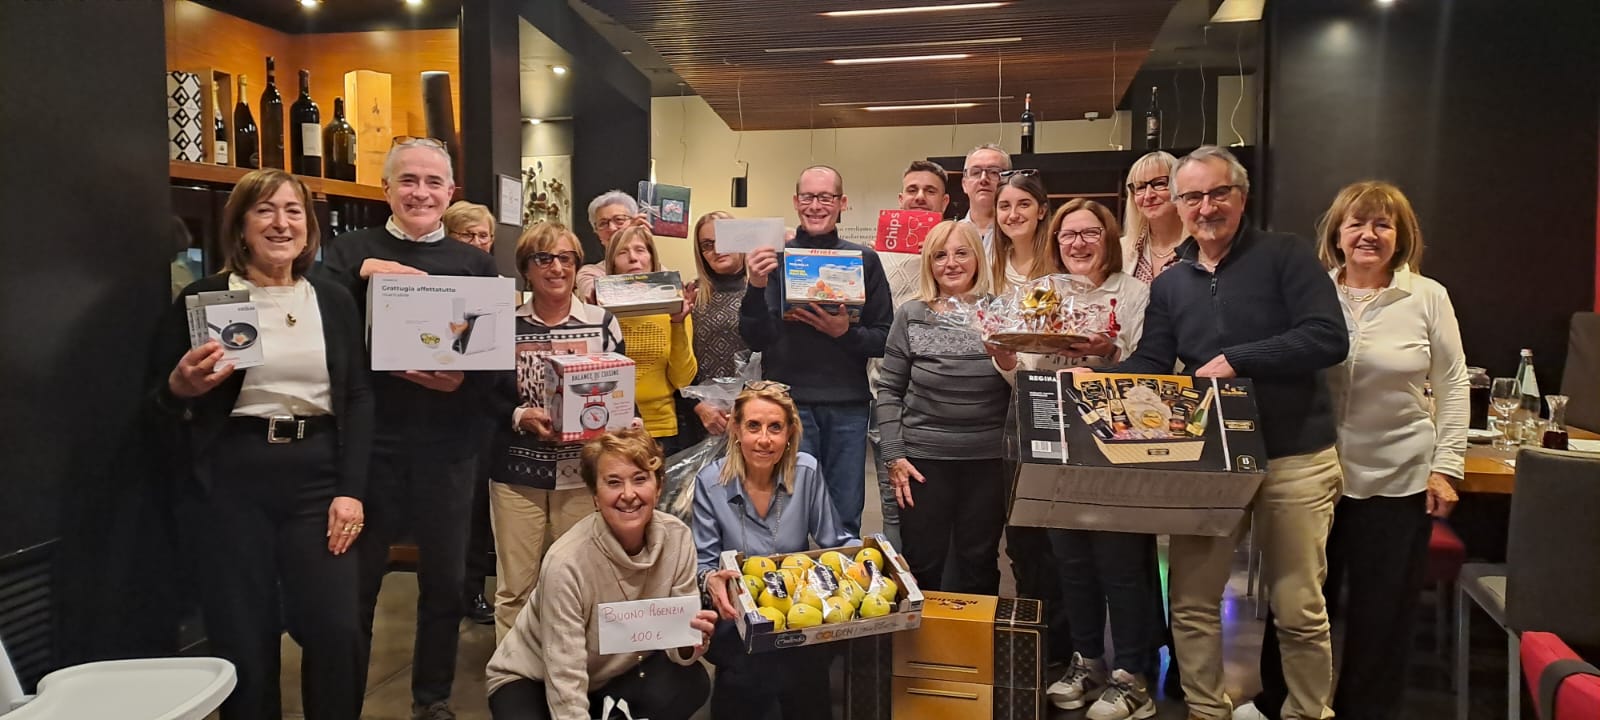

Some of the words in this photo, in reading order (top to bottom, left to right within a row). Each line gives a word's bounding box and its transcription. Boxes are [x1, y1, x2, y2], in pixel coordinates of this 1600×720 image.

[885, 212, 901, 249] Chips
[571, 373, 592, 381] BALANCE
[602, 606, 644, 623] BUONO
[649, 603, 685, 617] AGENZIA
[631, 630, 652, 642] 100
